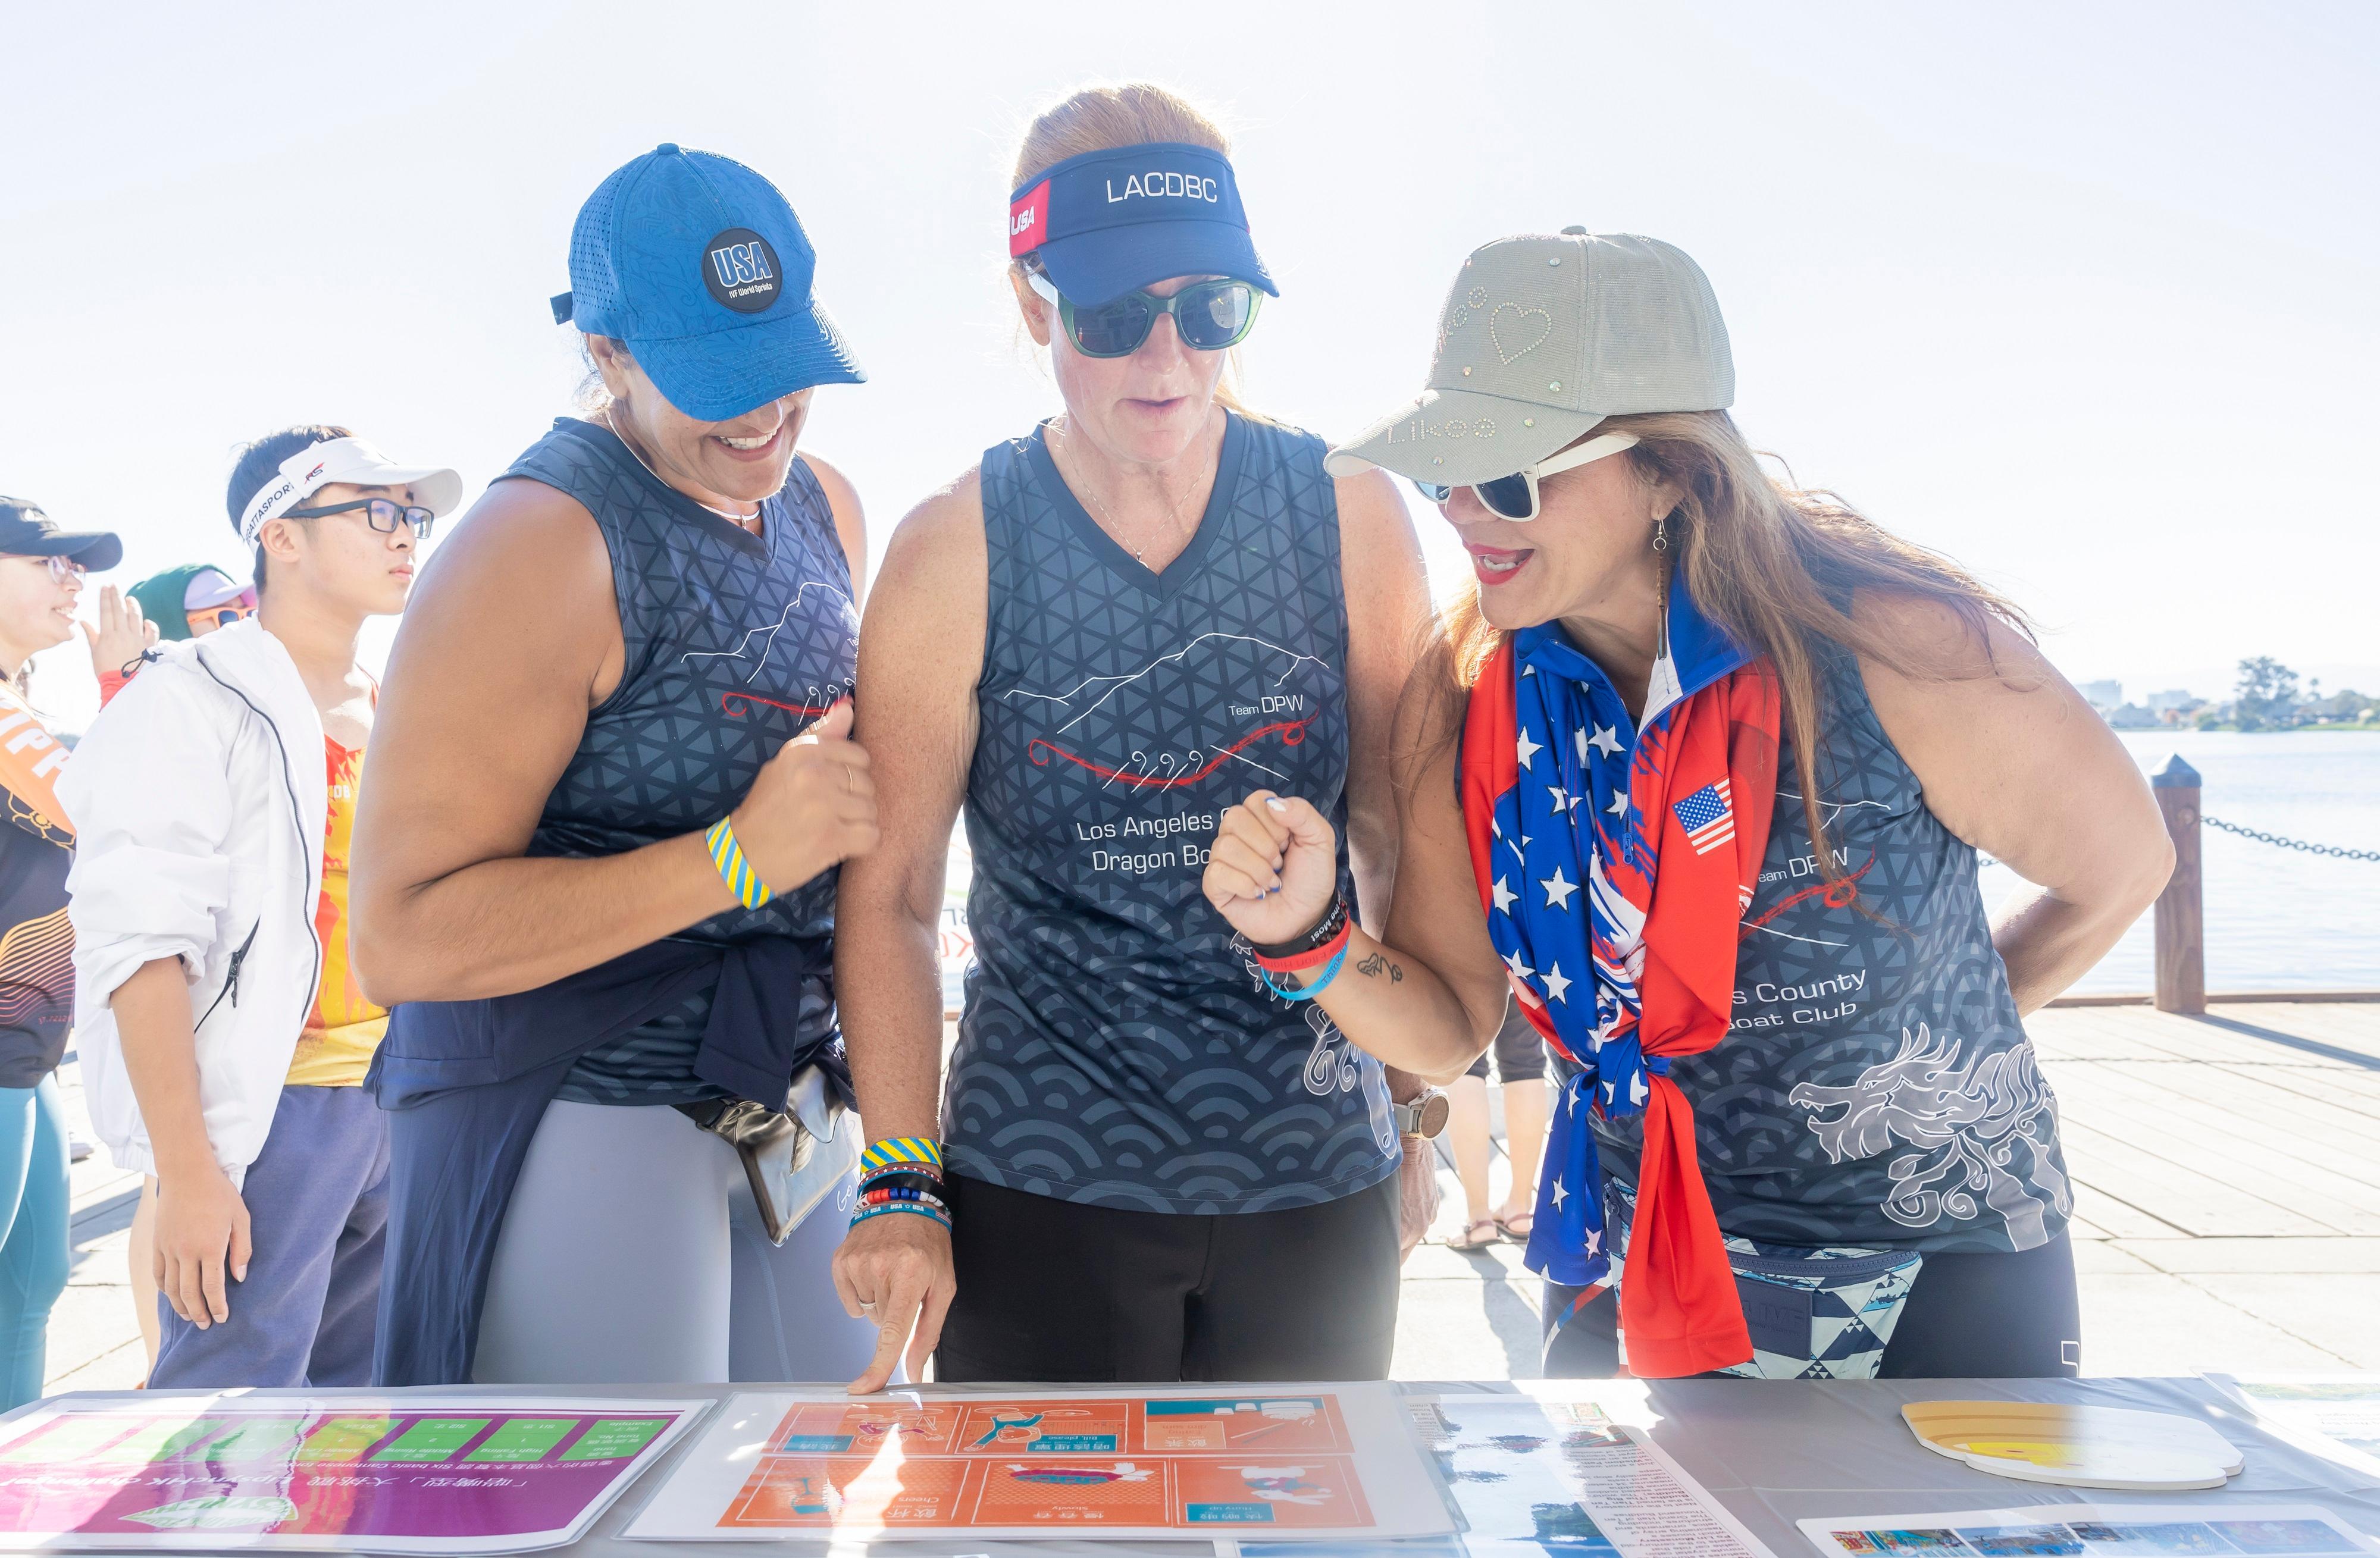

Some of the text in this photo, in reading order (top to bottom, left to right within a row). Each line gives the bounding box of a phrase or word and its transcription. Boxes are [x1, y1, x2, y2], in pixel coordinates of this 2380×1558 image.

[1107, 172, 1217, 203] LACDBC
[711, 242, 773, 287] USA
[729, 283, 773, 299] IVF World Sprints
[1388, 418, 1496, 444] Likee
[1228, 694, 1303, 716] Team DPW
[1077, 823, 1116, 840] Los
[1123, 811, 1213, 838] Angeles
[1092, 845, 1211, 874] Dragon Bo
[1758, 869, 1787, 882] eam
[1311, 919, 1332, 942] Most
[1321, 956, 1342, 983] Think
[1756, 969, 1866, 1002] County
[1793, 1002, 1857, 1024] Club
